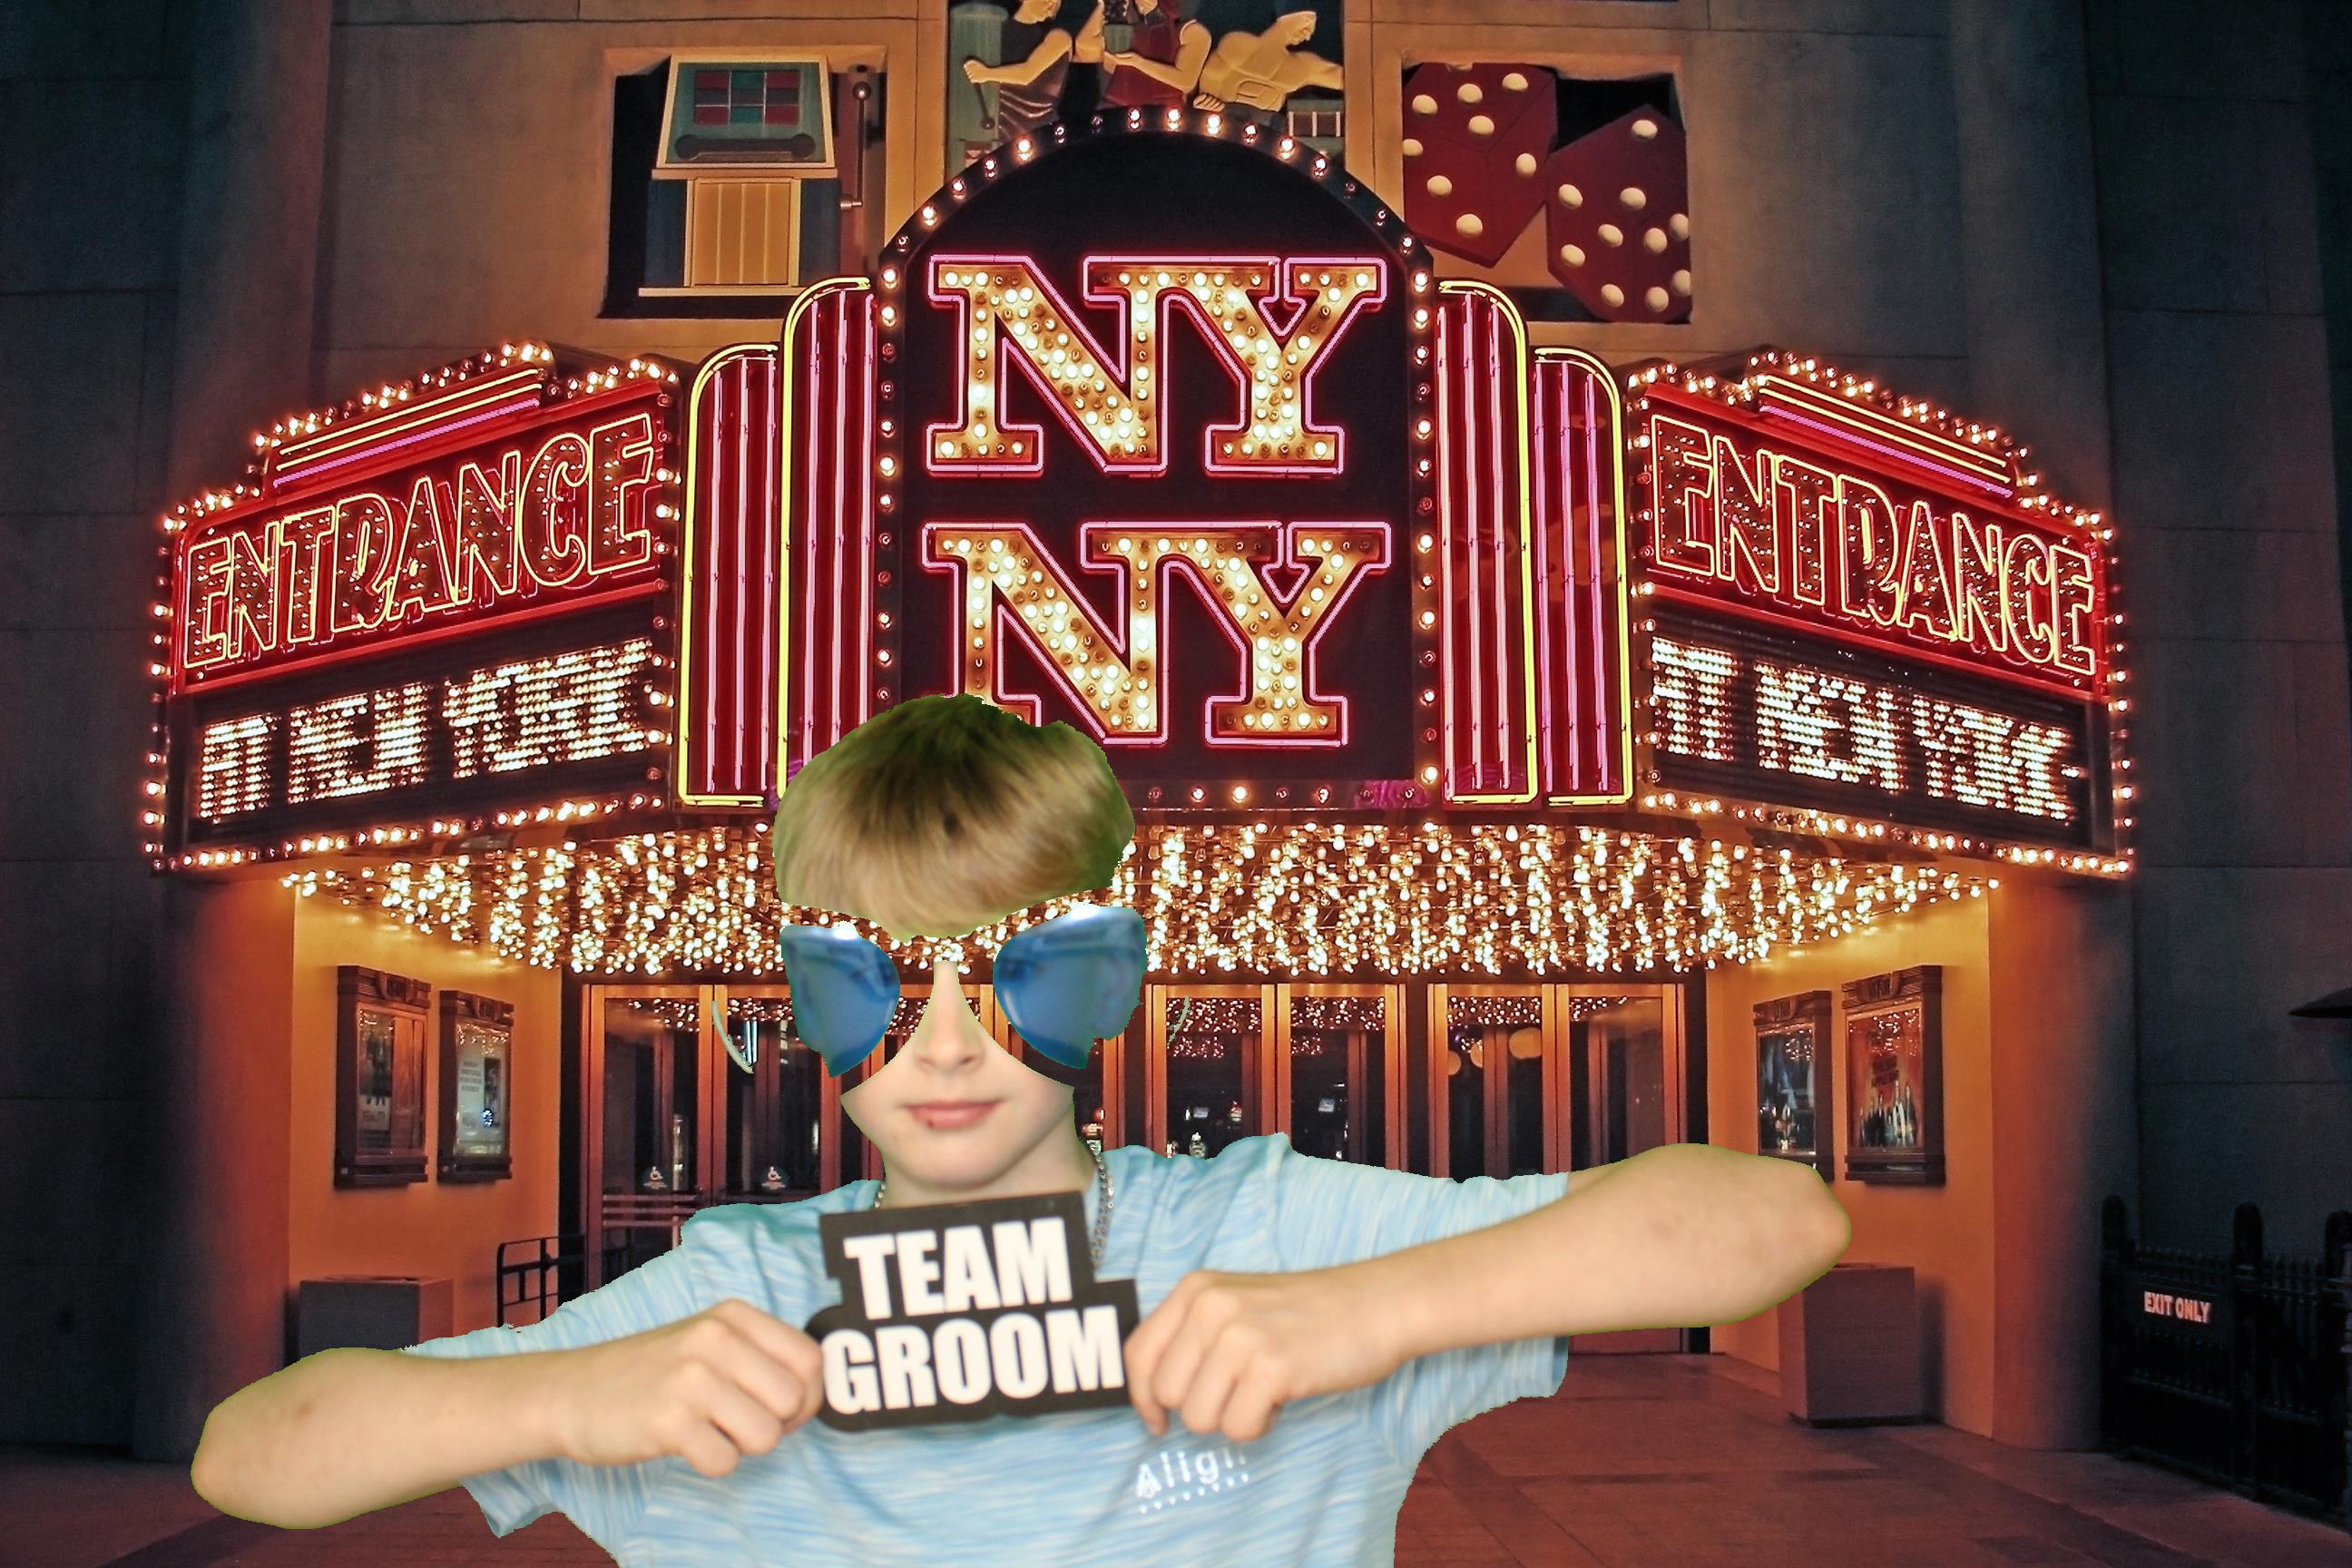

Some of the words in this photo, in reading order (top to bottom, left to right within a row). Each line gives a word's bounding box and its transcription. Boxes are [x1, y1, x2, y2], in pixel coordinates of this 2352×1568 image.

[926, 255, 1387, 475] NY
[184, 413, 652, 668] ENTRANCE
[922, 522, 1392, 747] NY
[1651, 413, 2096, 675] ENTRANCE
[820, 1305, 1124, 1416] GROOM
[843, 1217, 1073, 1320] TEAM
[2143, 1290, 2174, 1317] EXIT
[2175, 1297, 2212, 1324] ONLY
